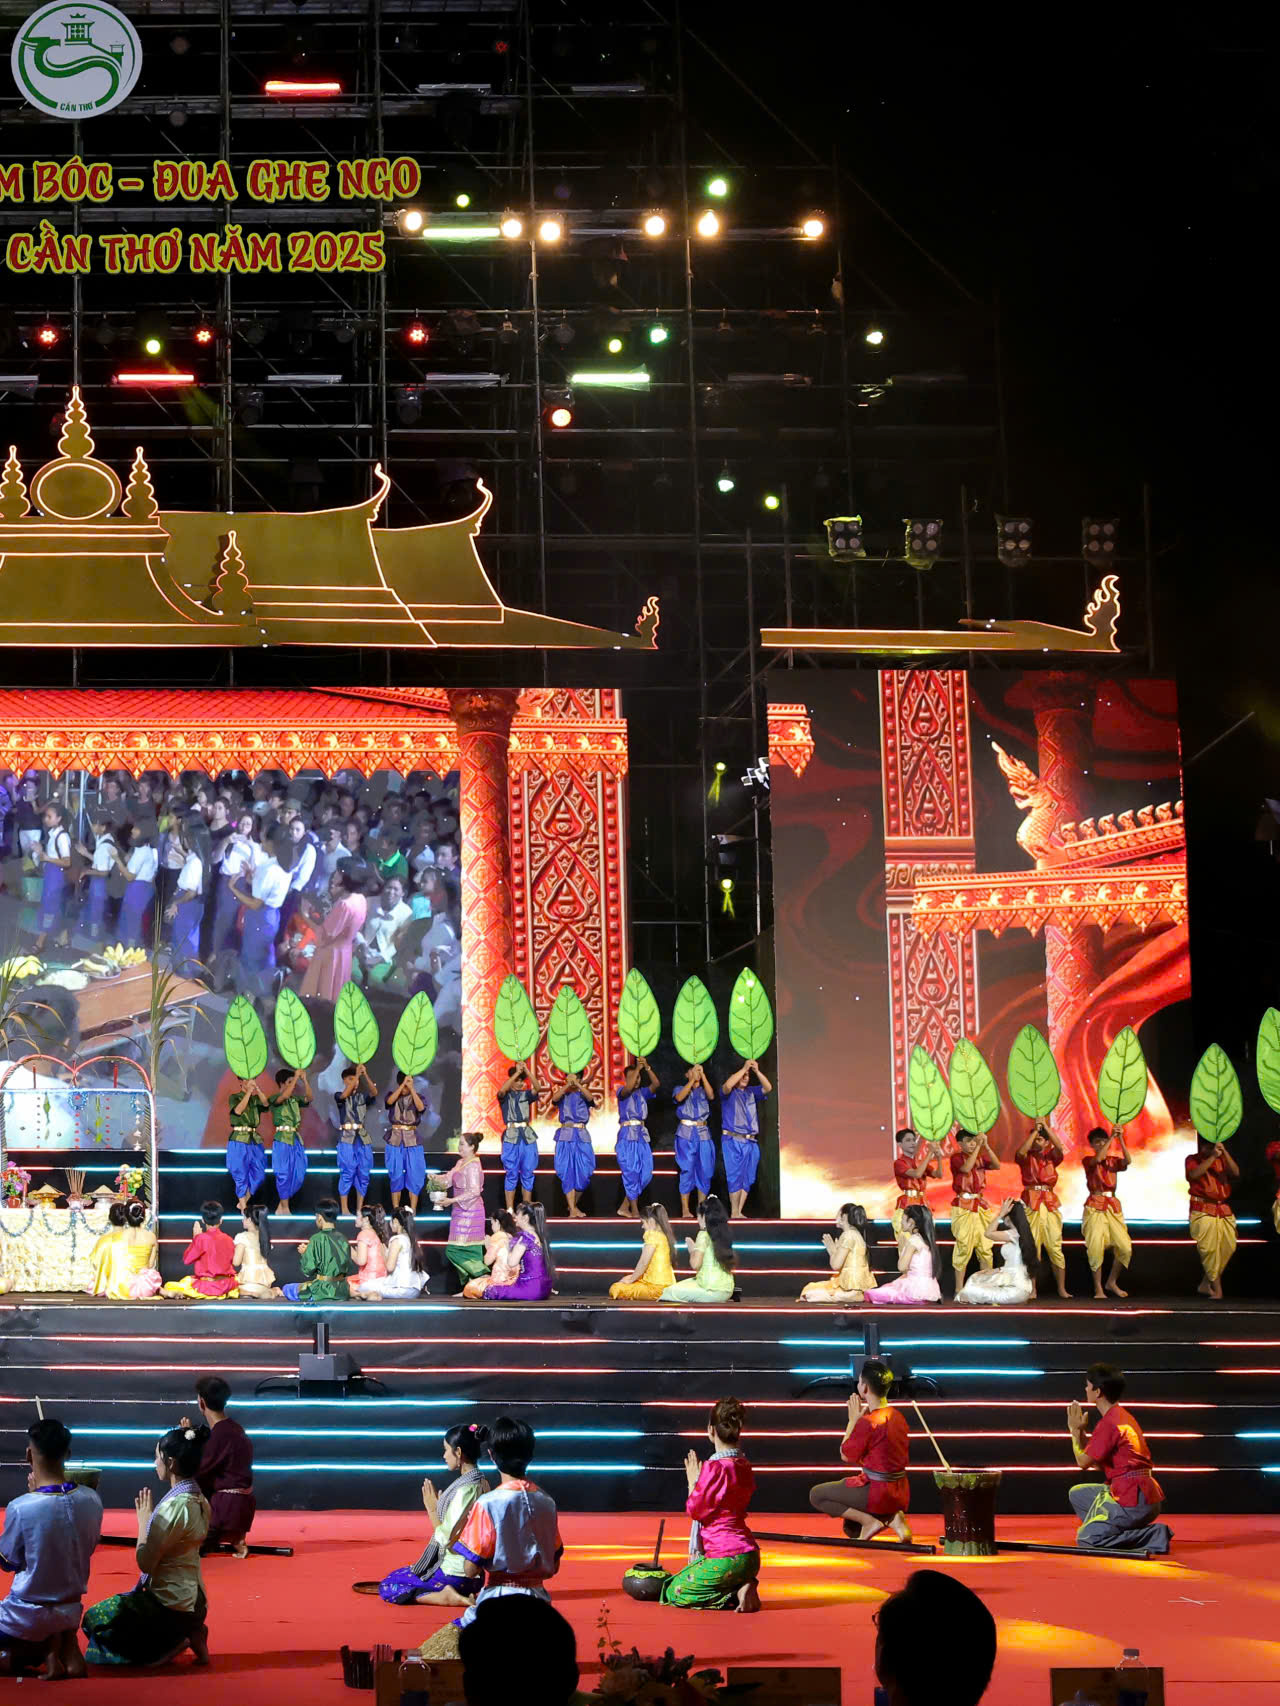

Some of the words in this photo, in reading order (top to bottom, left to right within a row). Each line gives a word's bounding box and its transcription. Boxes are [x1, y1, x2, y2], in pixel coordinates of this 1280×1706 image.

[33, 155, 113, 202] BÓC
[153, 160, 238, 202] ĐUA
[247, 159, 330, 203] GHE
[337, 157, 421, 202] NGO
[6, 219, 92, 274] CẦN
[99, 228, 182, 274] THƠ
[189, 224, 282, 273] NĂM
[288, 230, 386, 273] 2025
